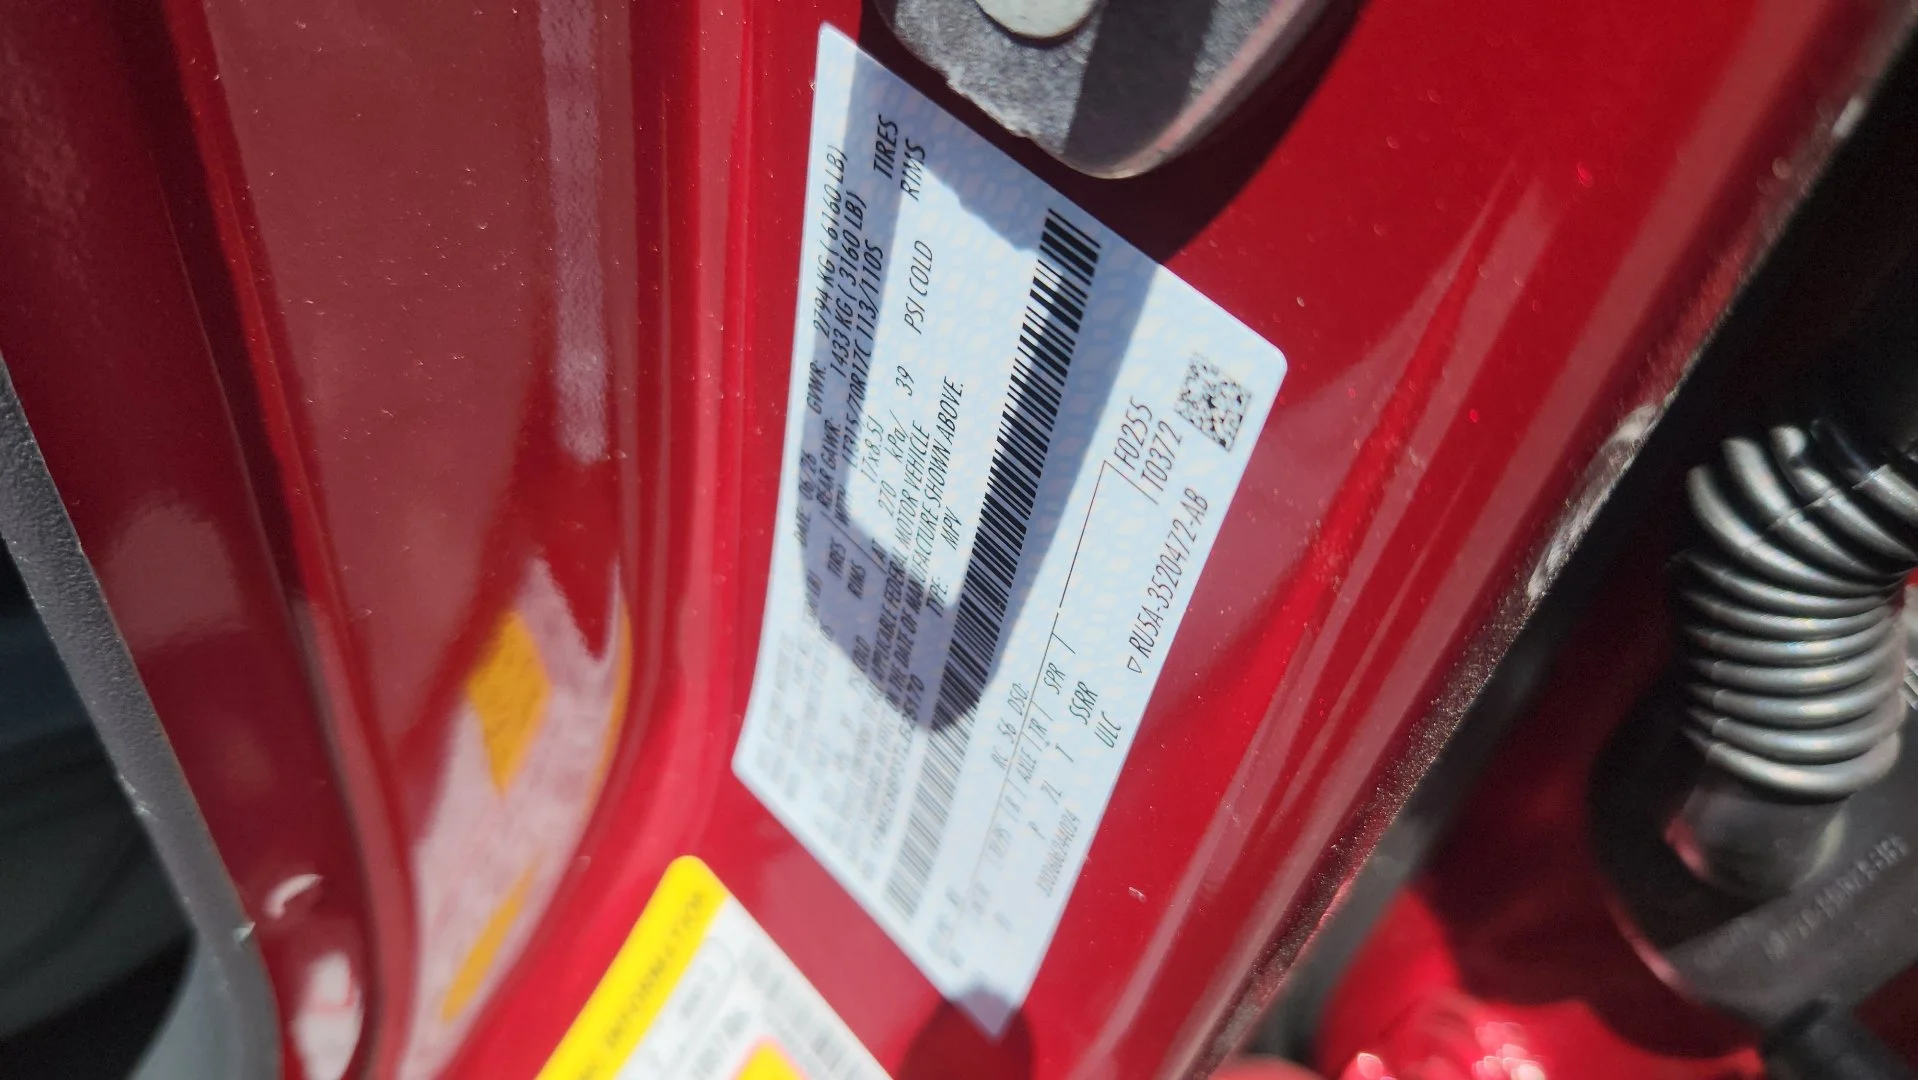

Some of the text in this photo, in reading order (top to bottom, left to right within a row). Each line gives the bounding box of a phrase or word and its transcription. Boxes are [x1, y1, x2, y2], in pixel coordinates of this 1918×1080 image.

[825, 140, 847, 187] LB)
[820, 180, 842, 242] 6160
[844, 188, 866, 232] LB)
[816, 251, 835, 290] KG
[838, 226, 860, 287] 3160
[813, 283, 832, 340] 2794
[834, 295, 853, 331] KG
[834, 112, 898, 528] WITH LT315/70R17C 113/110S TIRES
[860, 135, 926, 484] 17x8.5J RIMS
[830, 324, 849, 379] 1433
[806, 354, 826, 416] GVWR:
[871, 235, 934, 565] AT 270 kPa/ 39 PSI COLD
[935, 370, 963, 444] ABOVE.
[821, 413, 840, 471] GAWR:
[903, 419, 930, 493] VEHICLE
[798, 446, 816, 502] 06/26
[816, 466, 833, 512] REAR
[924, 436, 950, 508] SHOWN
[894, 486, 917, 549] MOTOR
[827, 536, 845, 579] TIRES
[847, 557, 865, 600] RIMS
[884, 545, 906, 610] FEDERAL
[904, 500, 939, 615] MANUFACTURE
[926, 505, 962, 618] TYPE: MPV
[1129, 484, 1209, 659] RU5A-3520472-AB
[870, 602, 897, 683] APPLICABLE
[894, 626, 913, 669] DATE
[900, 607, 918, 634] OF
[852, 632, 870, 674] COLD
[889, 662, 905, 693] THE
[884, 687, 900, 712] ON
[997, 715, 1017, 744] 56
[1007, 678, 1030, 717] DSO:
[1014, 746, 1036, 784] AXLE
[1028, 716, 1047, 741] TR
[1043, 660, 1065, 695] SPR
[1068, 679, 1097, 726] SSRR
[1094, 709, 1121, 749] ULC
